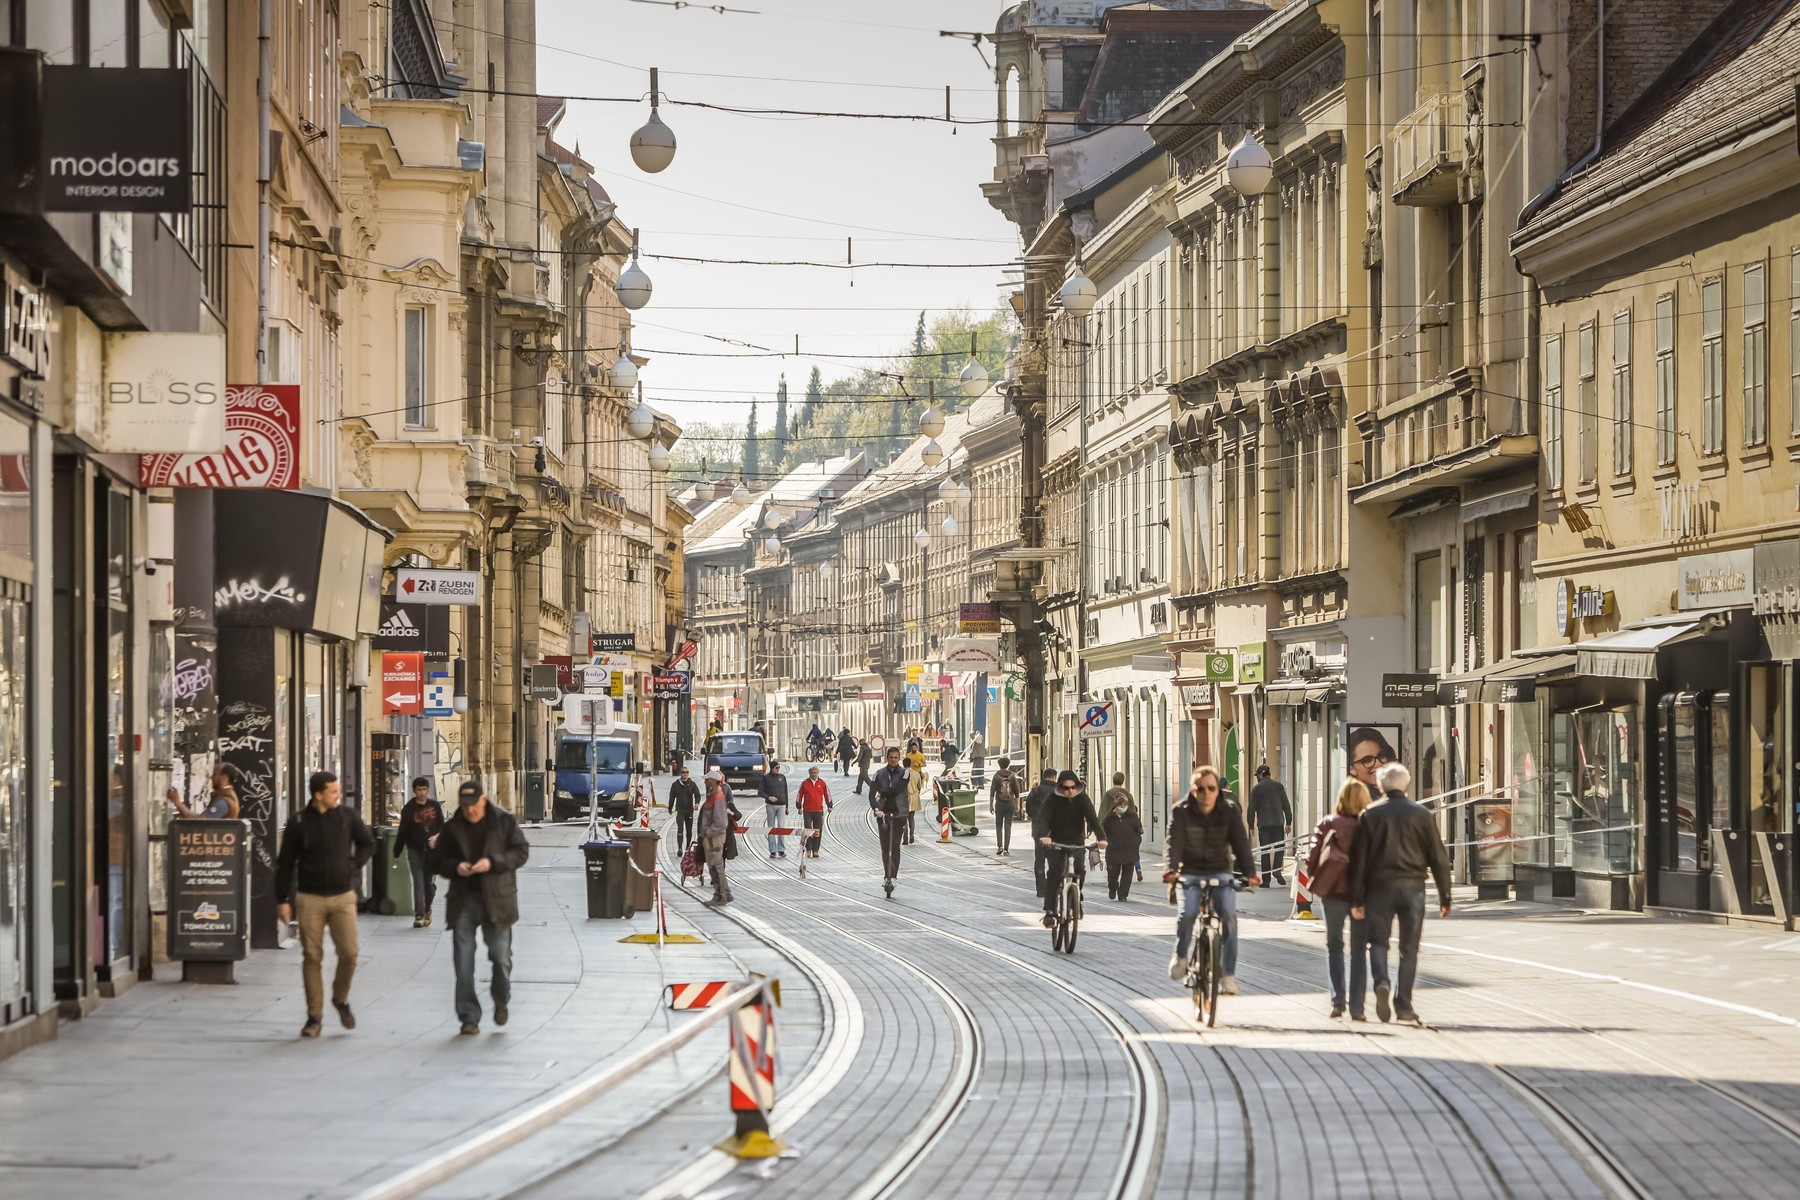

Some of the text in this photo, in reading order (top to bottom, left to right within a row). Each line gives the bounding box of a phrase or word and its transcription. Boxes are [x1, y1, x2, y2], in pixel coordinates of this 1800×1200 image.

[50, 152, 180, 177] modoars
[65, 186, 165, 197] INTERIOR DESIGN
[108, 382, 217, 405] BLISS
[439, 581, 474, 589] ZUBNI
[438, 588, 474, 596] RENDGEN
[378, 626, 420, 637] adidas
[593, 638, 634, 646] STRUGAR
[655, 676, 673, 685] Triumph
[1385, 684, 1436, 692] MASS
[910, 701, 916, 709] P
[180, 833, 236, 845] HELLO
[180, 846, 235, 856] ZAGREB!
